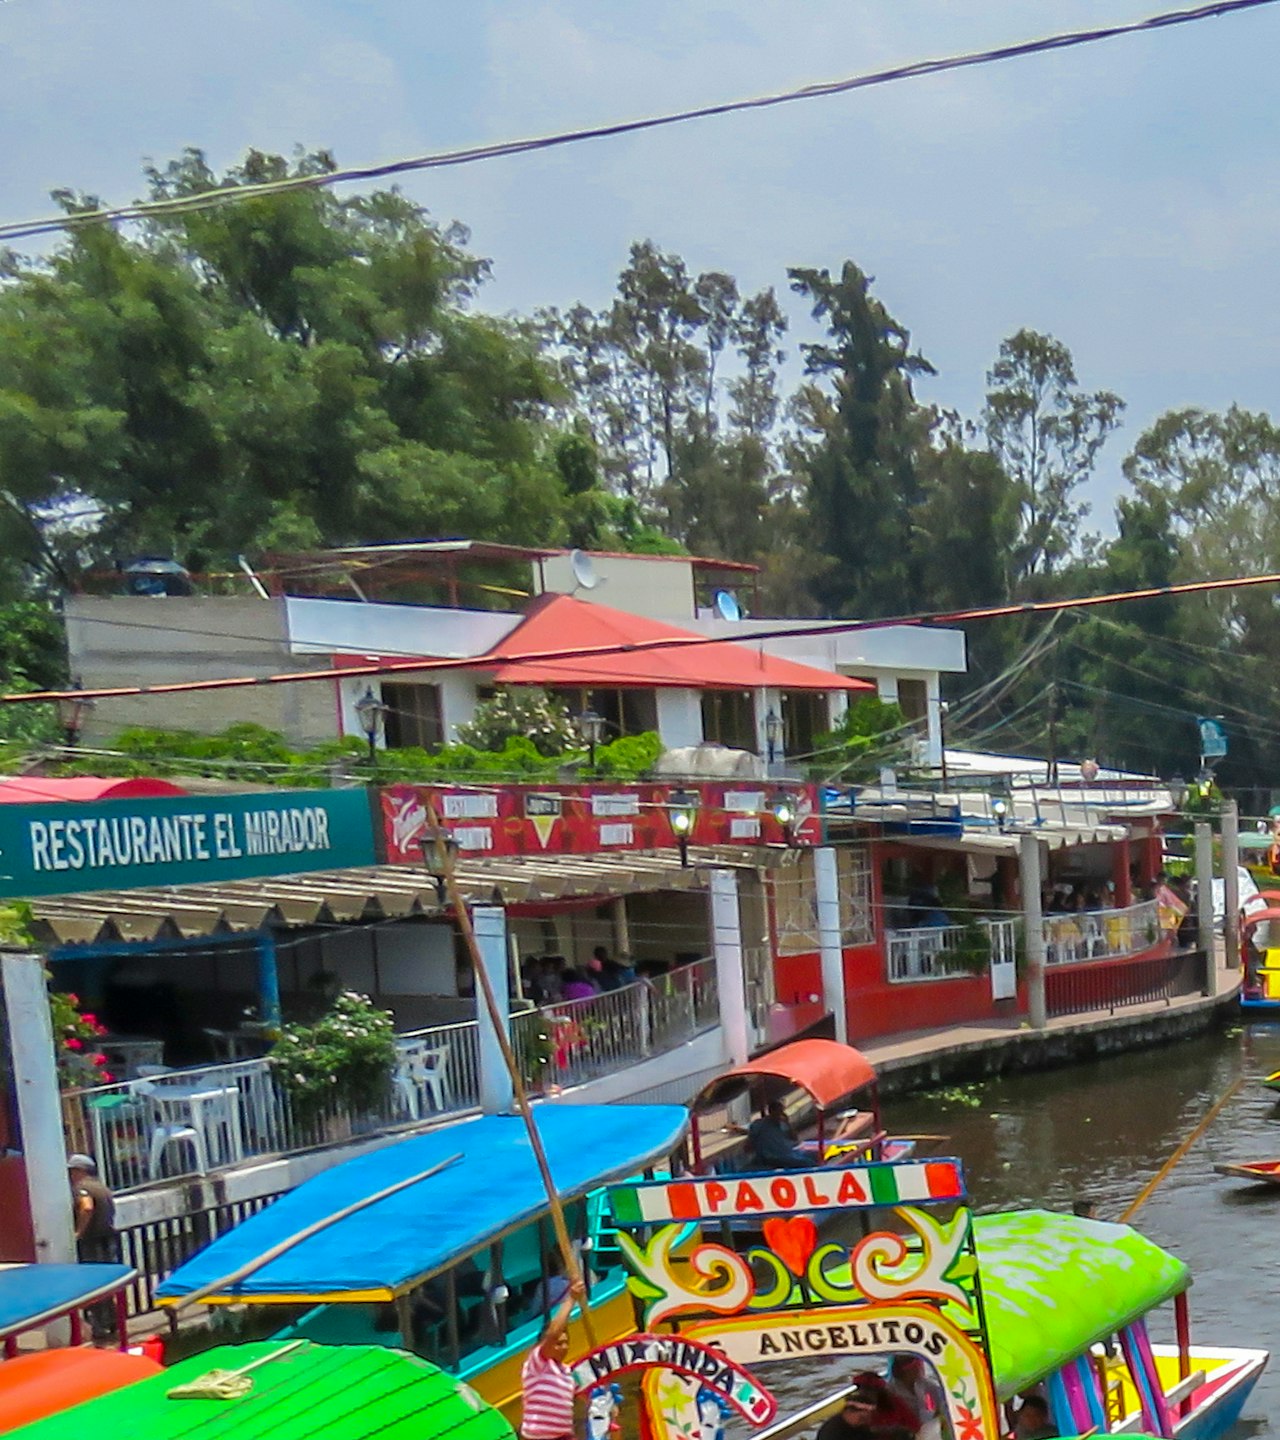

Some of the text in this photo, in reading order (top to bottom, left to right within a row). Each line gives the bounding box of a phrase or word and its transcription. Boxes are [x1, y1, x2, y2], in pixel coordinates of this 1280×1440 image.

[30, 814, 211, 871] RESTAURANTE
[214, 813, 242, 860] EL
[245, 807, 331, 856] MIRADOR
[704, 1170, 867, 1213] PAOLA
[758, 1320, 948, 1357] ANGELITOS
